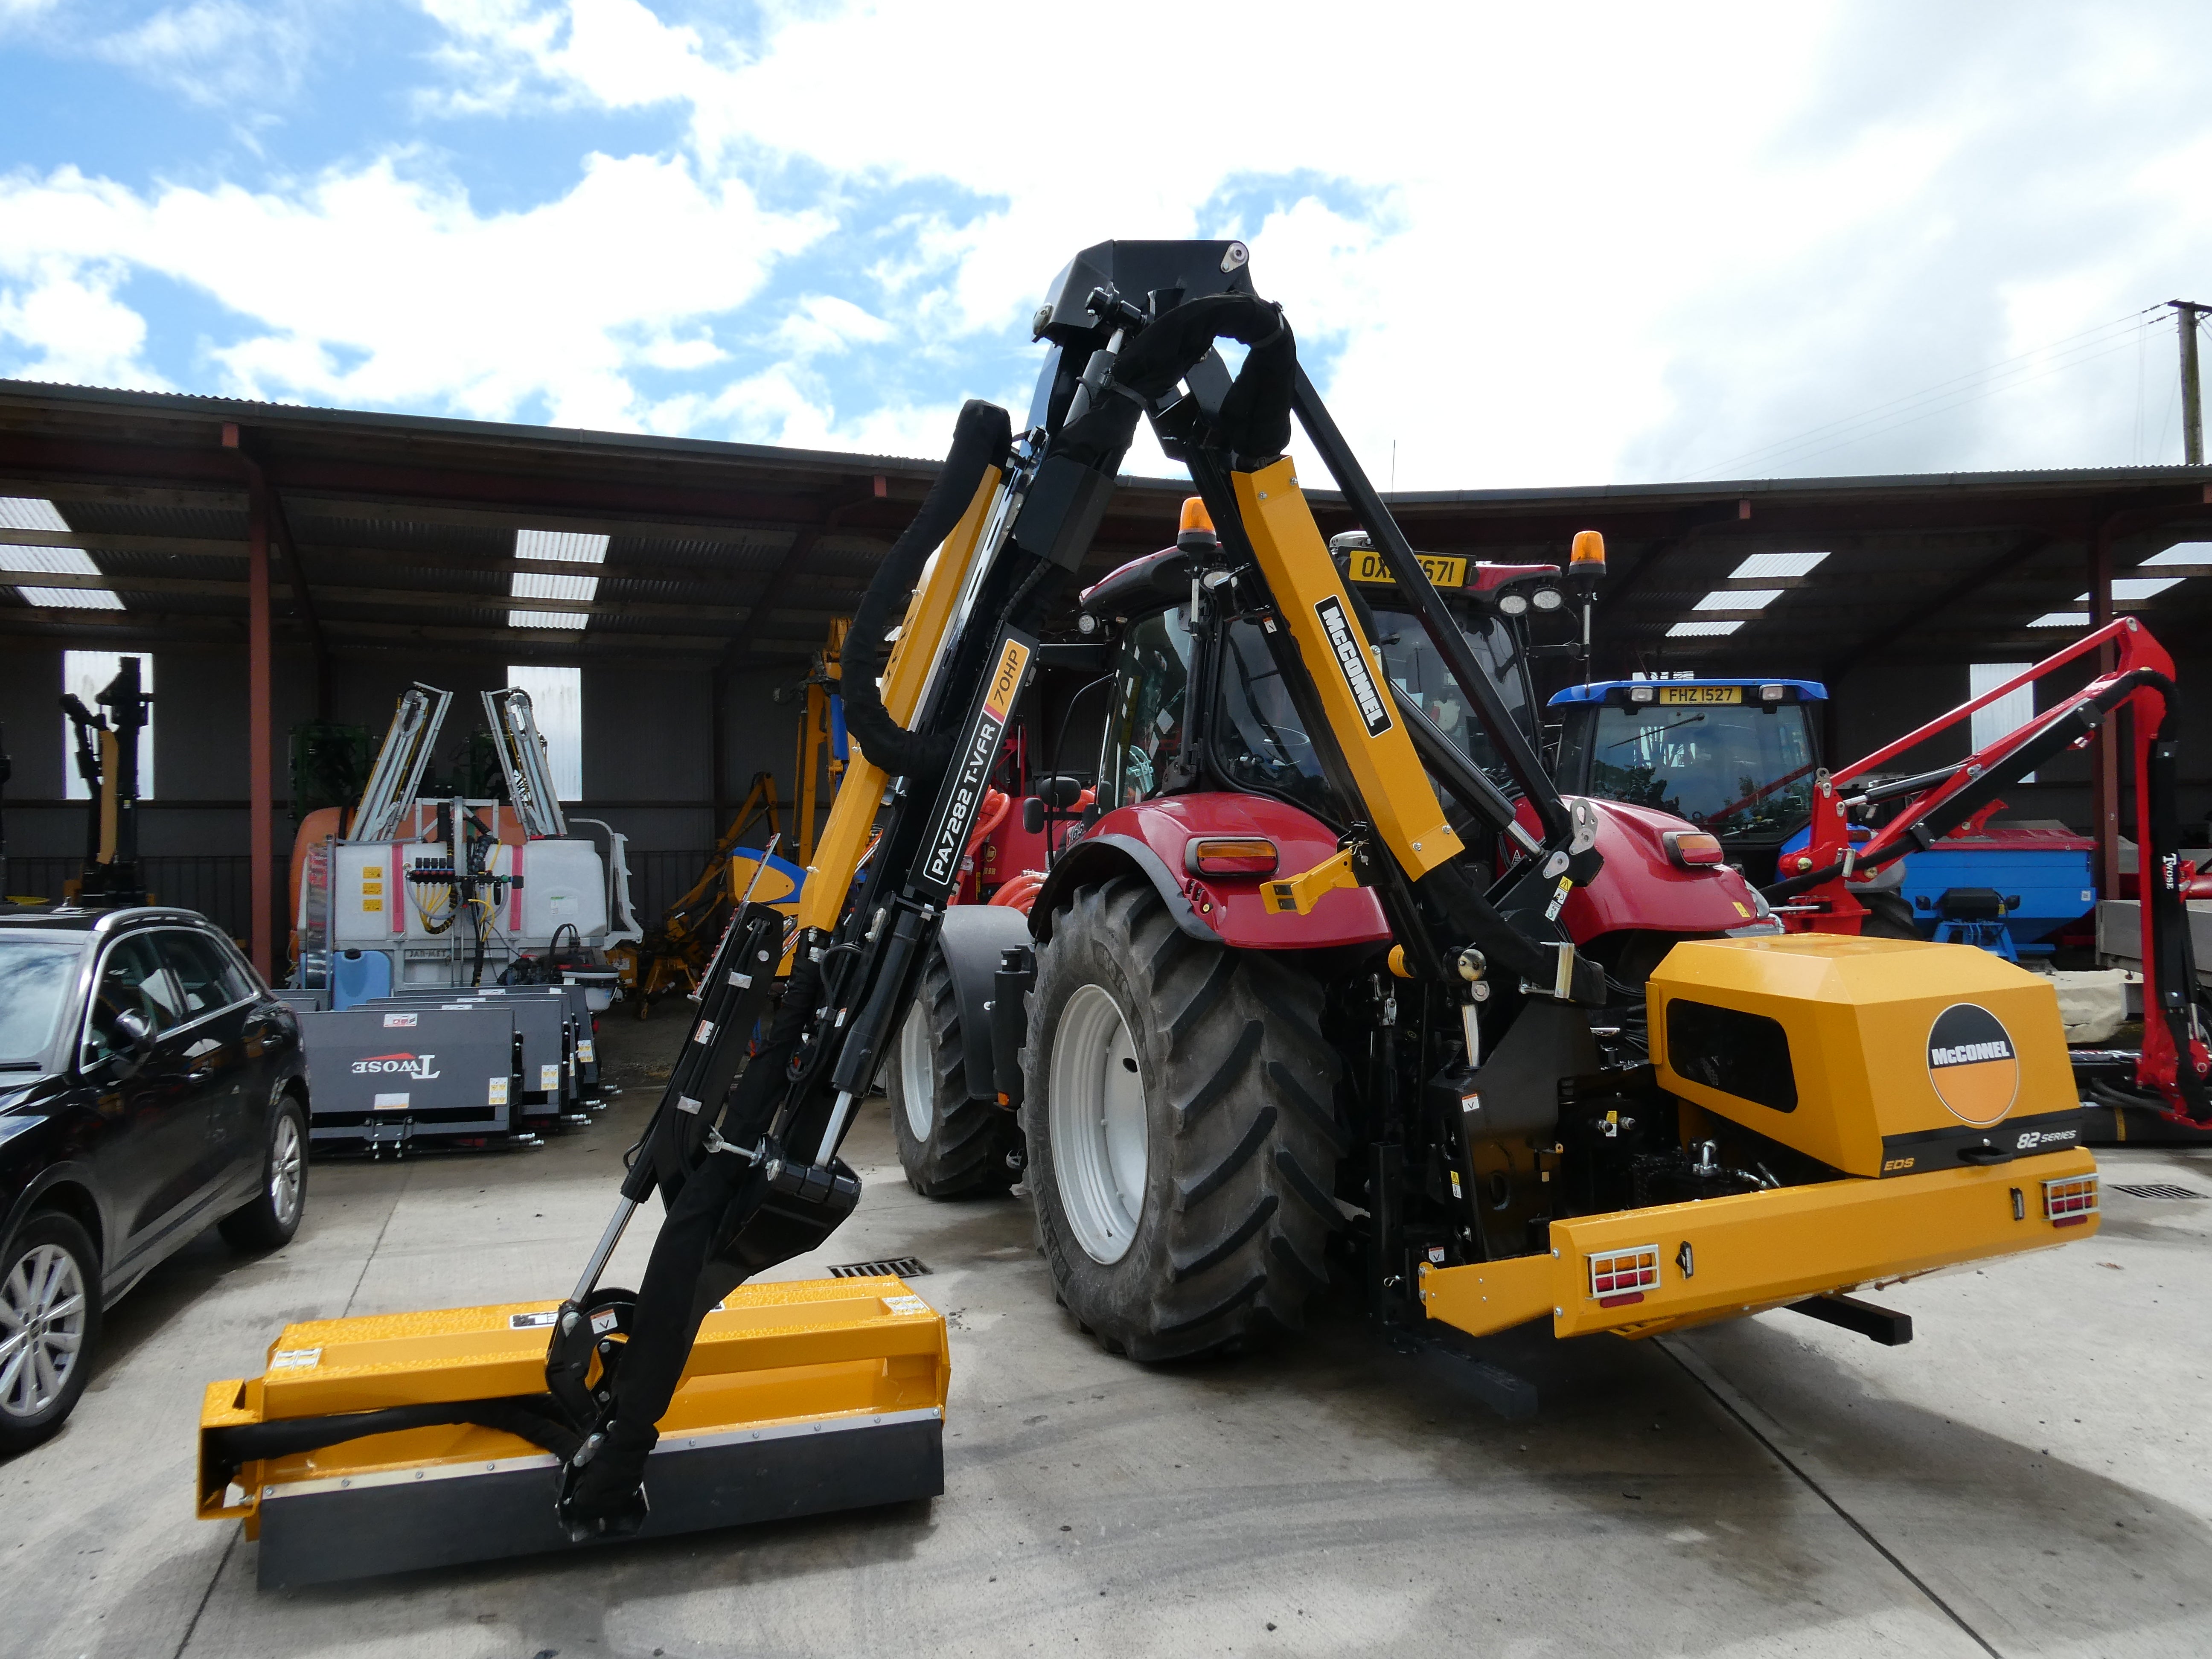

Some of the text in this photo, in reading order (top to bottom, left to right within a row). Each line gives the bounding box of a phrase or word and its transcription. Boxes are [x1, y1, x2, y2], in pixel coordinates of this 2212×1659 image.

[1669, 689, 1733, 701] FHZ 1527
[931, 649, 1019, 876] PA7282 T-VFR 70HP
[1931, 1041, 2010, 1065] McCONNEL
[2017, 1130, 2077, 1149] 82 SERIES
[1884, 1158, 1914, 1171] EDS
